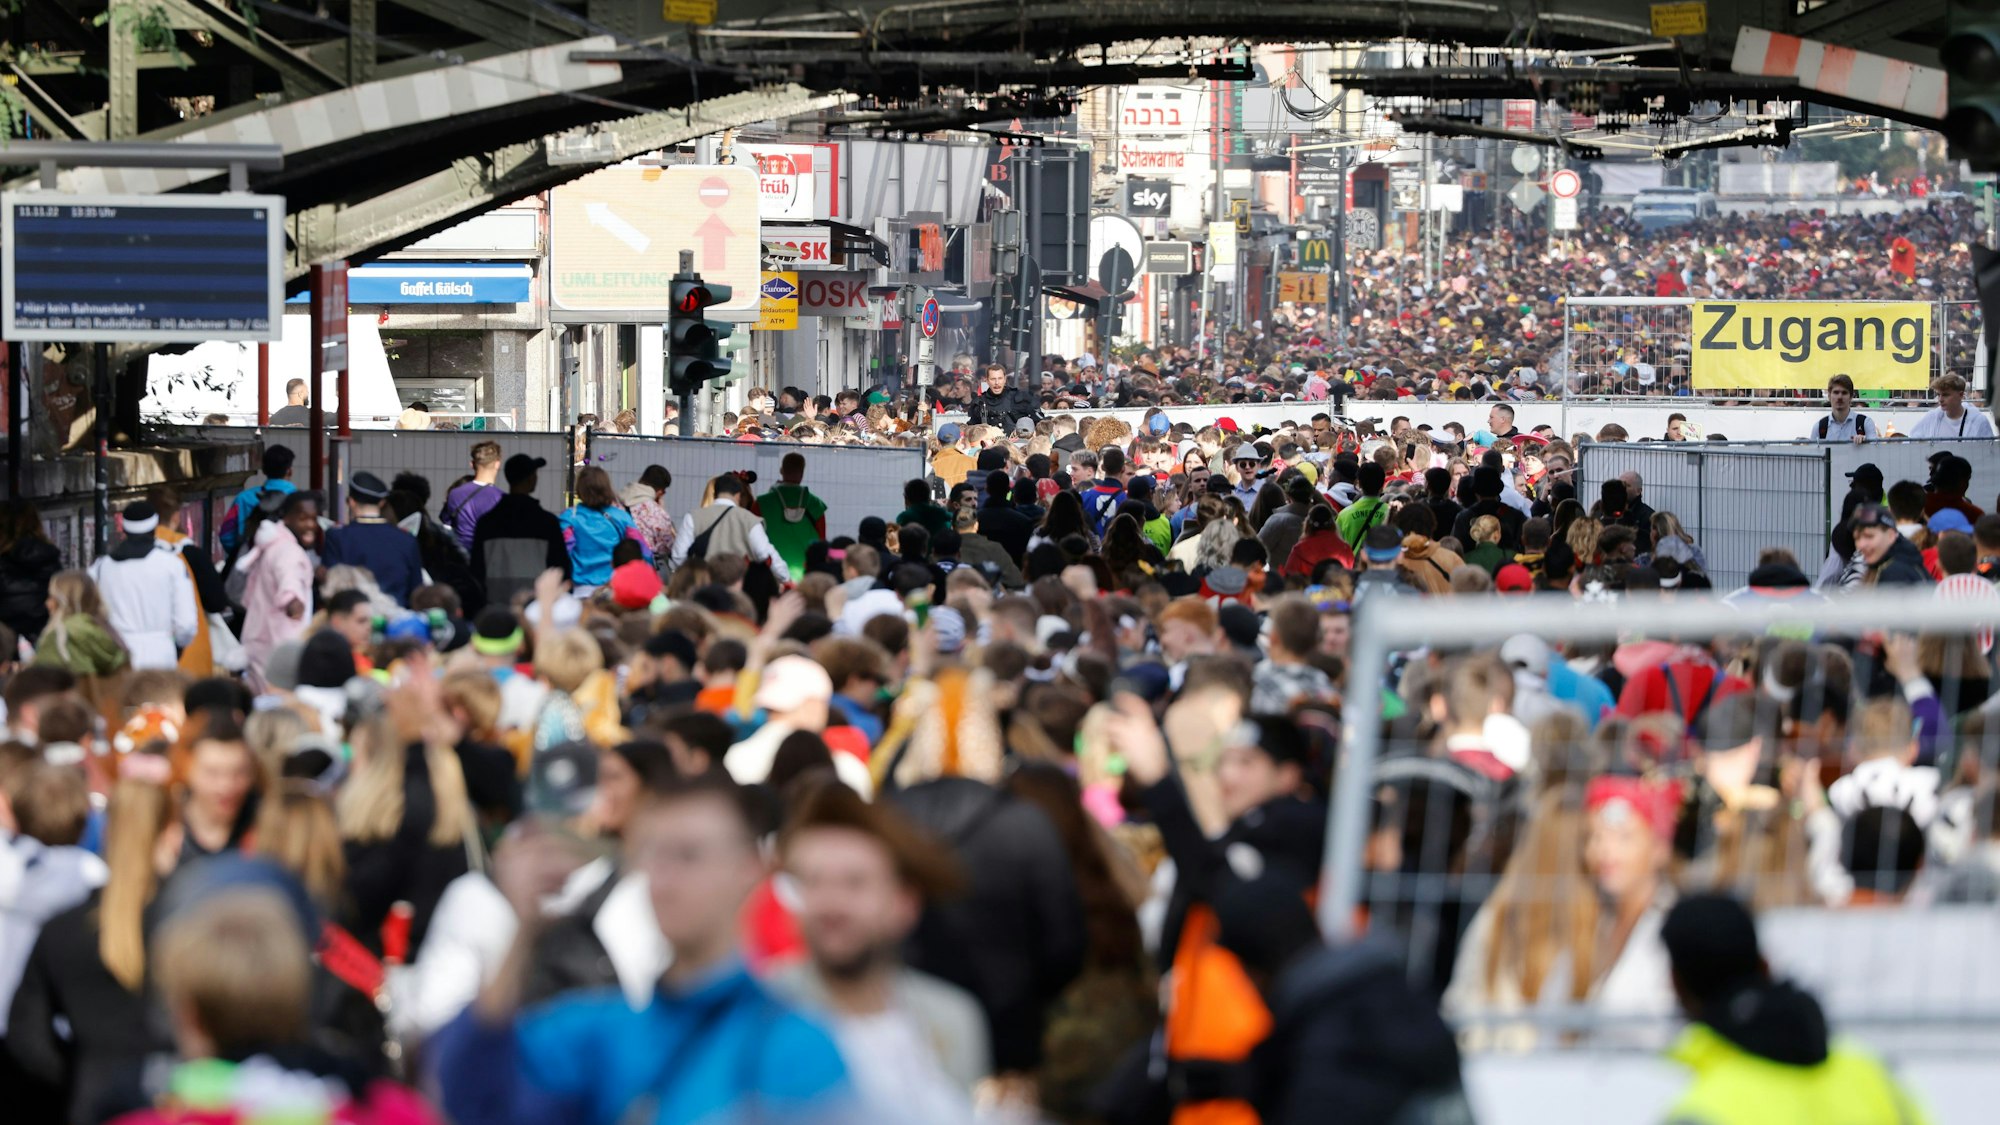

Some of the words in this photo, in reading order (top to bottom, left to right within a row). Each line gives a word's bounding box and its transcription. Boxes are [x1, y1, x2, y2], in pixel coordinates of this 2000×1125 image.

[1124, 108, 1181, 125] ברכה
[1122, 144, 1184, 167] Schawarma
[760, 178, 789, 195] früh
[1133, 188, 1167, 210] sky
[561, 272, 669, 288] UMLEITUNG
[763, 284, 792, 293] Euronet
[798, 279, 868, 308] IOSK
[23, 303, 48, 314] Hier
[71, 304, 136, 315] Bahnverkehr
[1700, 304, 1925, 364] Zugang
